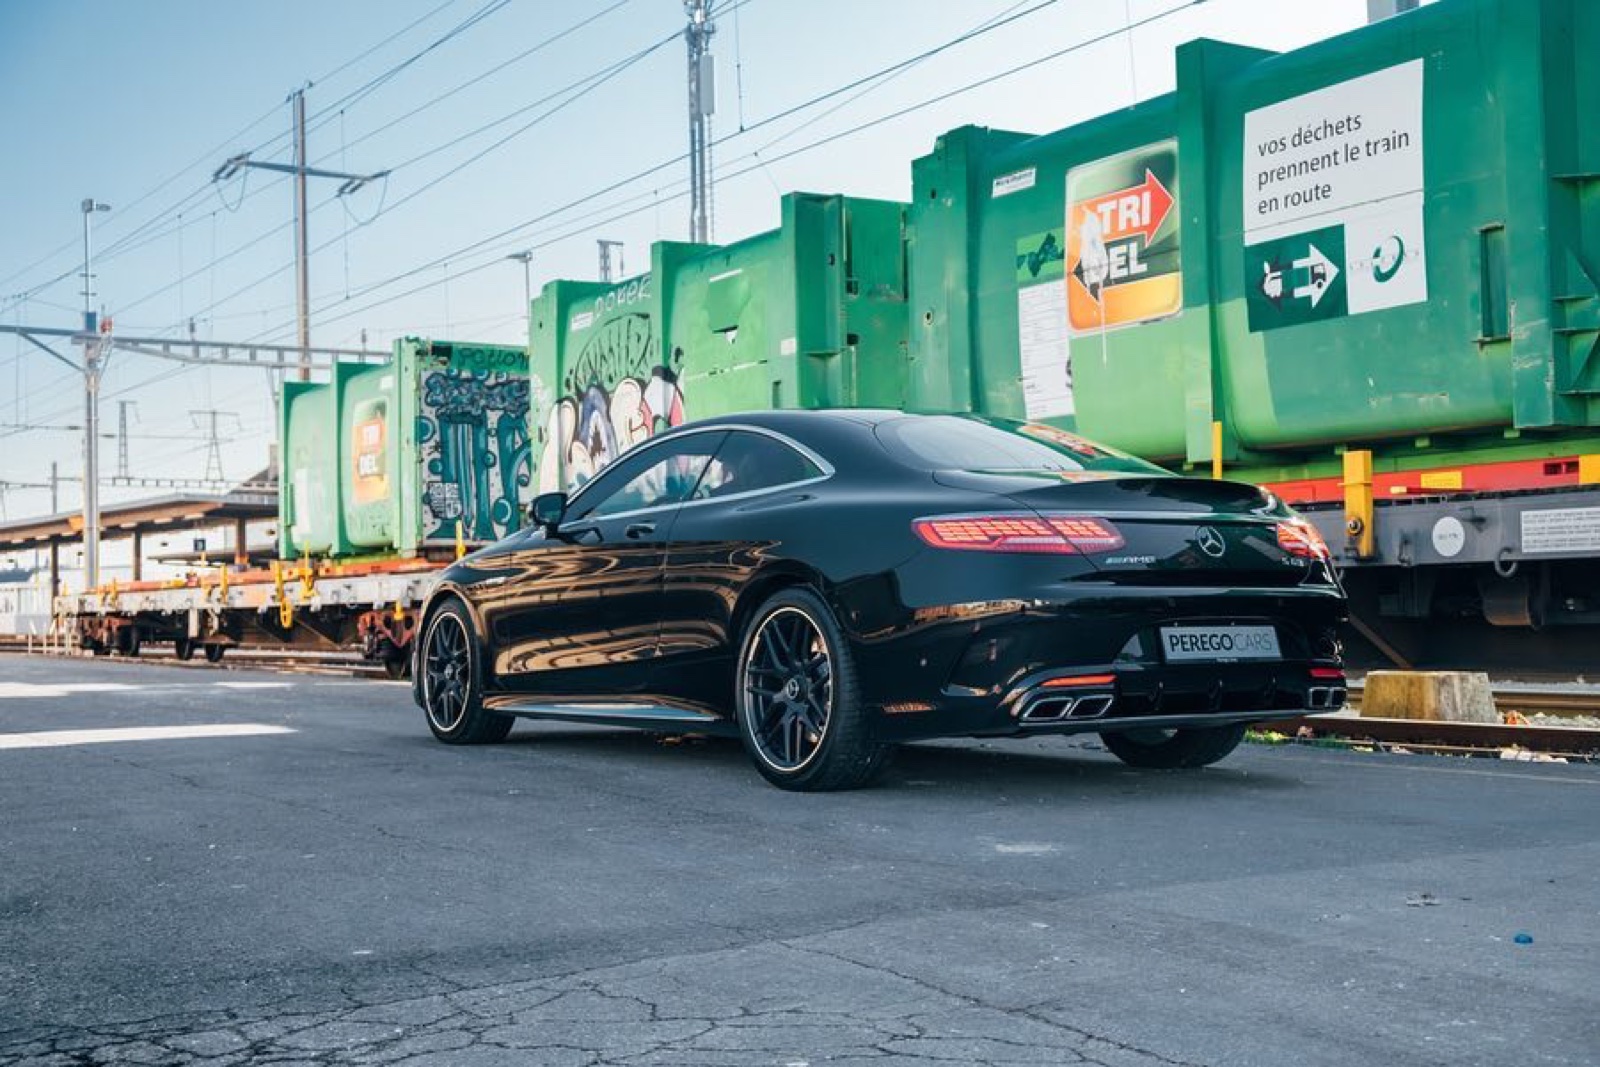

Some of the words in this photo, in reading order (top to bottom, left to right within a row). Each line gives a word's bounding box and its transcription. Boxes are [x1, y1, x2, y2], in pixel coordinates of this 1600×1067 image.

[1258, 136, 1287, 157] vos
[1291, 114, 1362, 148] déchets
[1258, 149, 1340, 191] prennent
[1344, 143, 1361, 163] le
[1365, 129, 1410, 157] train
[1097, 191, 1152, 235] TRI
[1258, 197, 1280, 215] en
[1283, 183, 1332, 209] route
